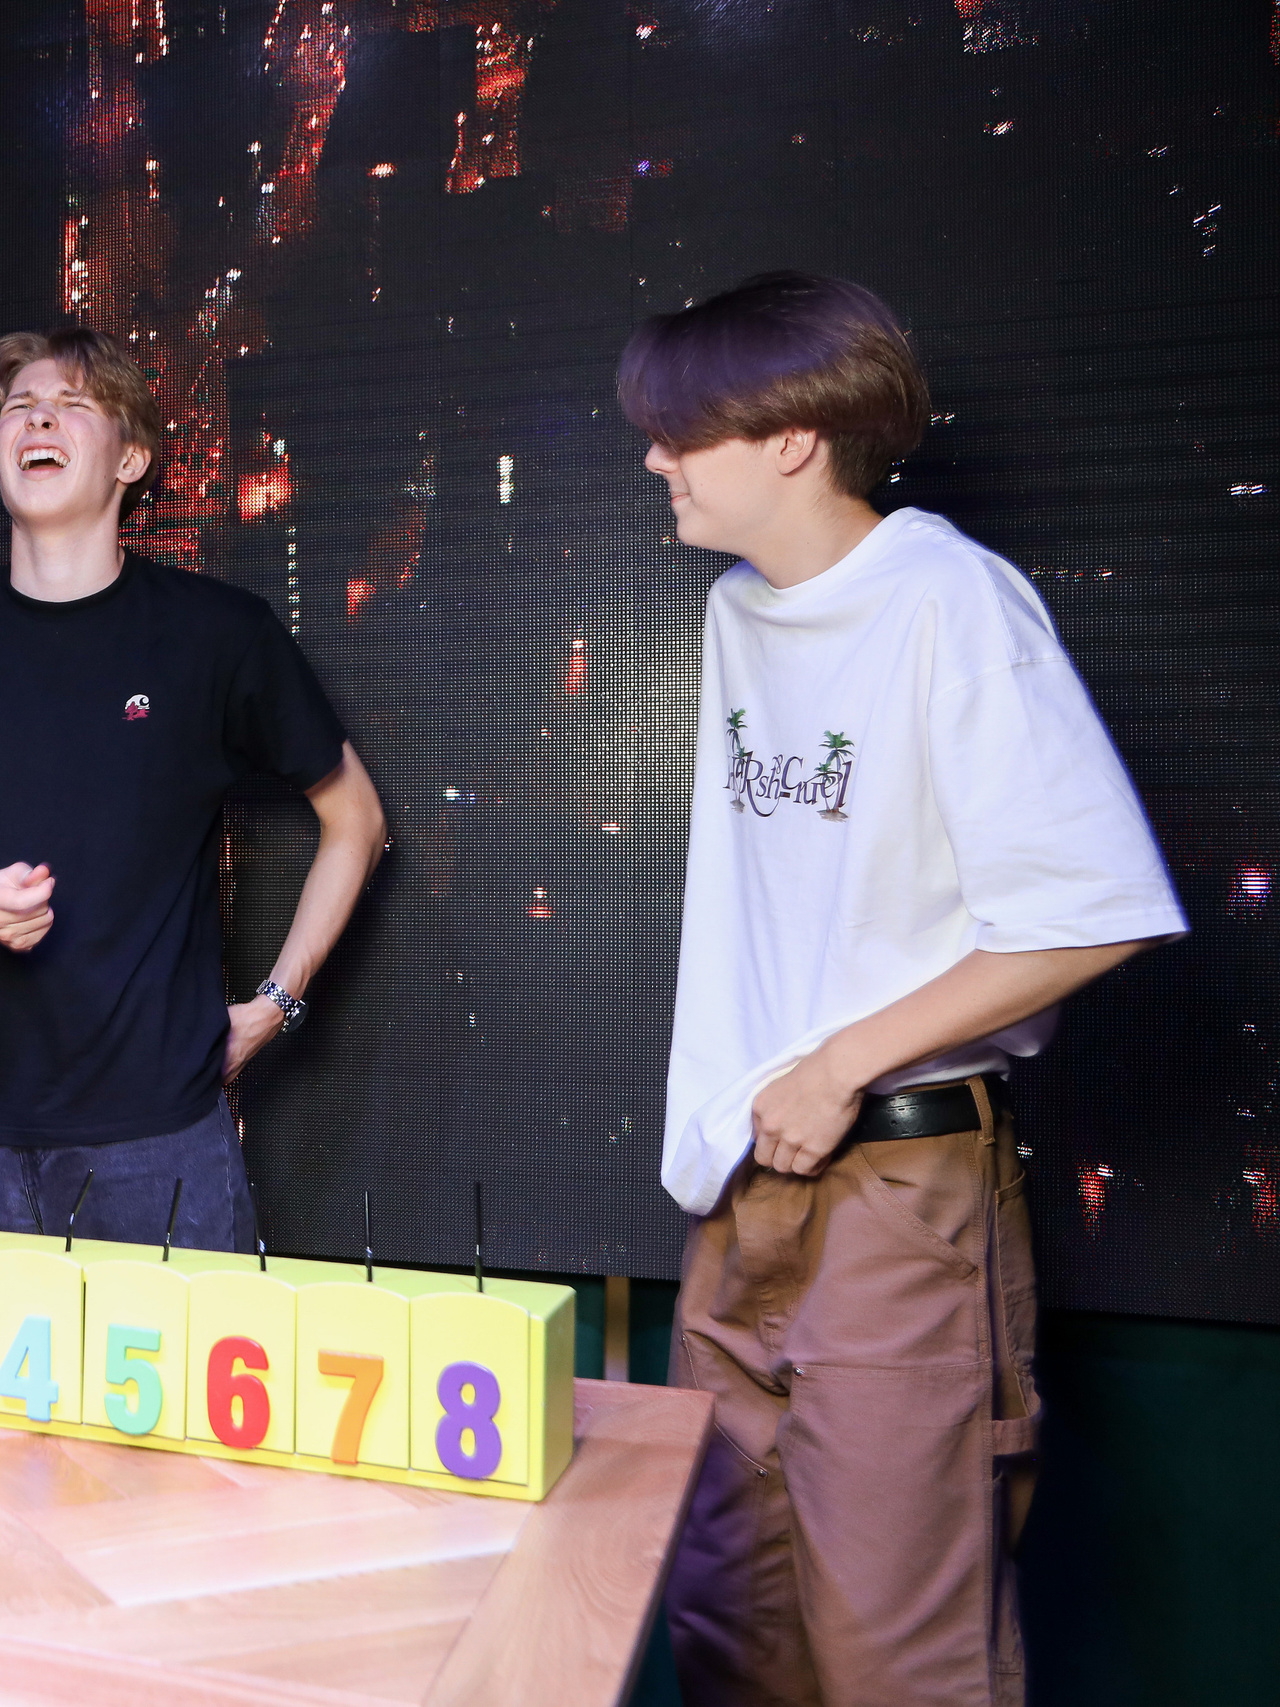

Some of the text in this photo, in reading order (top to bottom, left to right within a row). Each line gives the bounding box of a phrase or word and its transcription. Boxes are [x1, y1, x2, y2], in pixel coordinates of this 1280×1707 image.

[103, 1323, 163, 1436] 5
[206, 1335, 271, 1449] 6
[318, 1349, 384, 1465] 7
[435, 1360, 502, 1480] 8
